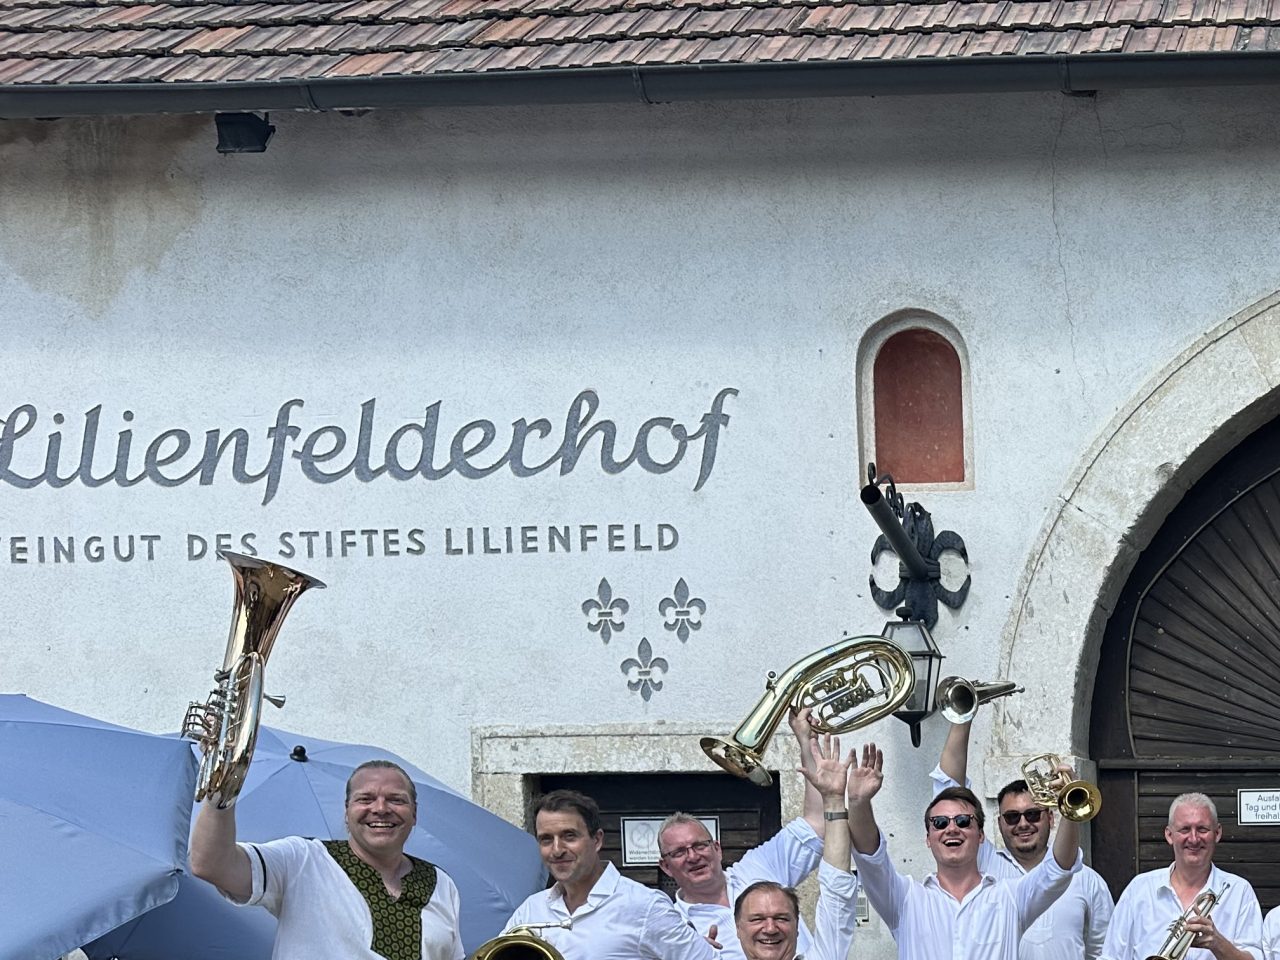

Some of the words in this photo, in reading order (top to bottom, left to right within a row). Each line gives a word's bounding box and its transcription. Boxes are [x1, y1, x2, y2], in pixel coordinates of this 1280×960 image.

[0, 387, 739, 506] Lilienfelderhof
[0, 534, 161, 564] EINGUT
[187, 533, 258, 561] DES
[279, 528, 426, 559] STIFTES
[445, 523, 680, 555] LILIENFELD
[1245, 803, 1259, 812] Tag
[1261, 803, 1277, 811] und
